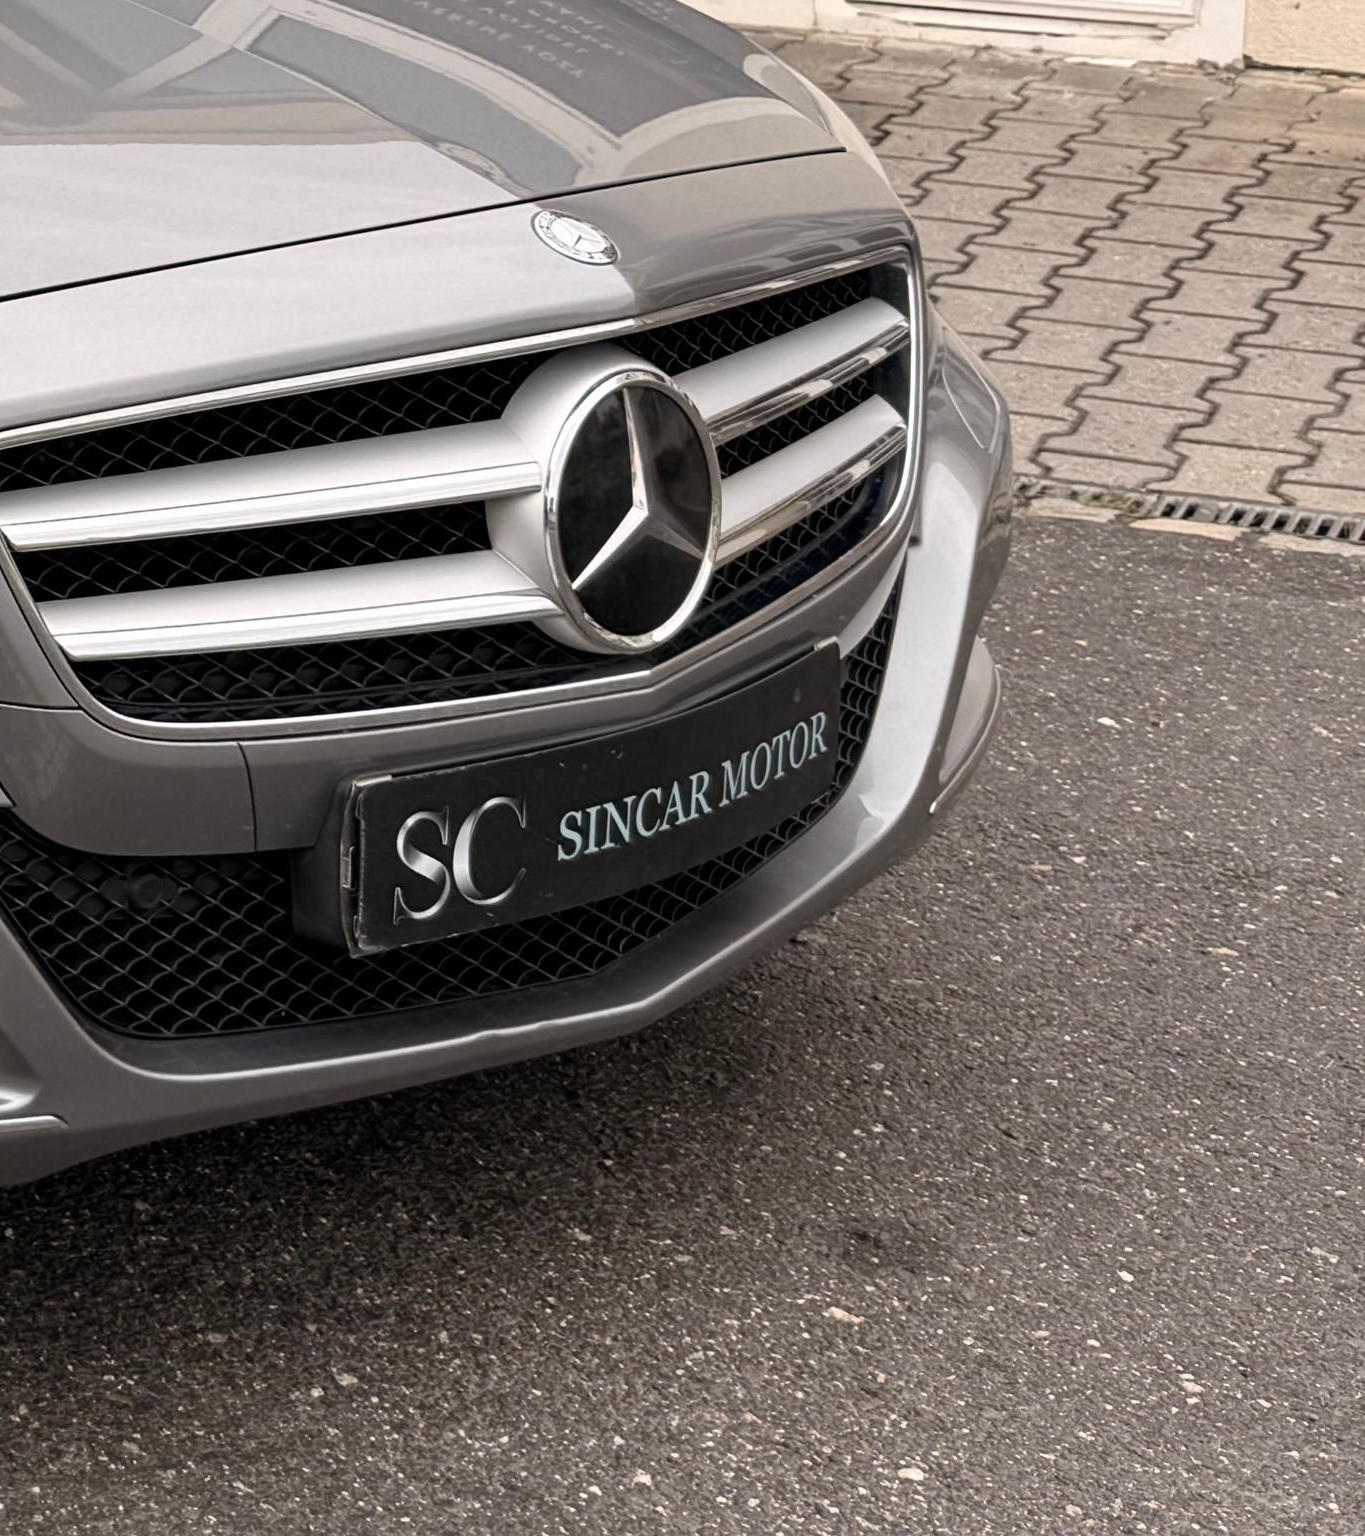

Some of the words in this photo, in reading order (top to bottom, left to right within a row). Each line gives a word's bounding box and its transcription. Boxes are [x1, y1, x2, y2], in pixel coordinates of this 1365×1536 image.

[393, 796, 527, 927] SC
[557, 770, 714, 862] SINCAR
[718, 710, 829, 810] MOTOR
